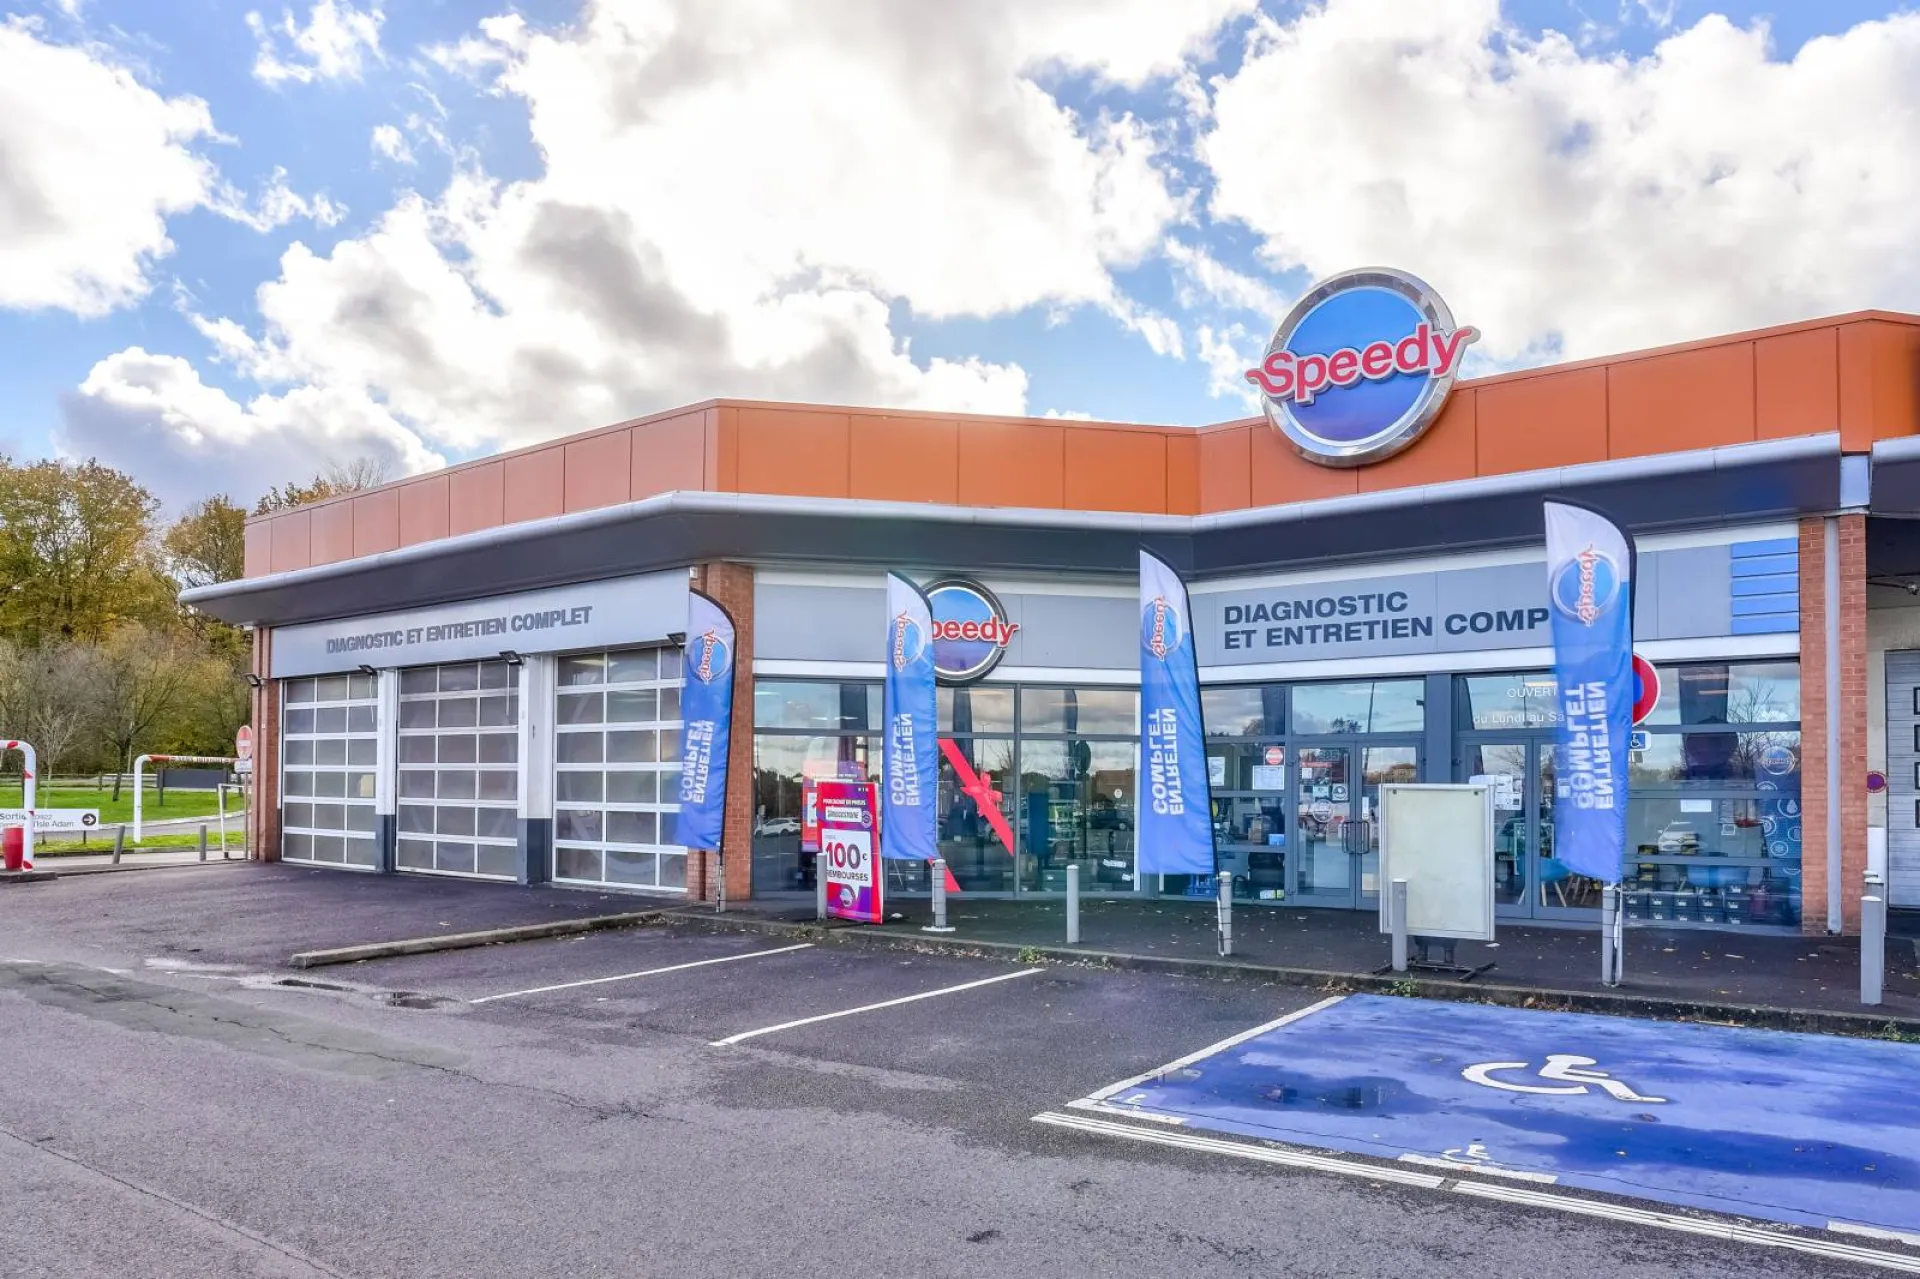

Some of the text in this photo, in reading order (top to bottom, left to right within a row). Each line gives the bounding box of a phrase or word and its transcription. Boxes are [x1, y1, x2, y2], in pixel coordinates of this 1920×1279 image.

[1245, 320, 1480, 403] Speedy
[1223, 591, 1409, 625] DIAGNOSTIC
[326, 606, 592, 654] DIAGNOSTIC ET ENTRETIEN COMPLET
[932, 615, 1020, 647] peedy
[1224, 608, 1549, 650] ET ENTRETIEN COMP
[826, 842, 860, 869] 100
